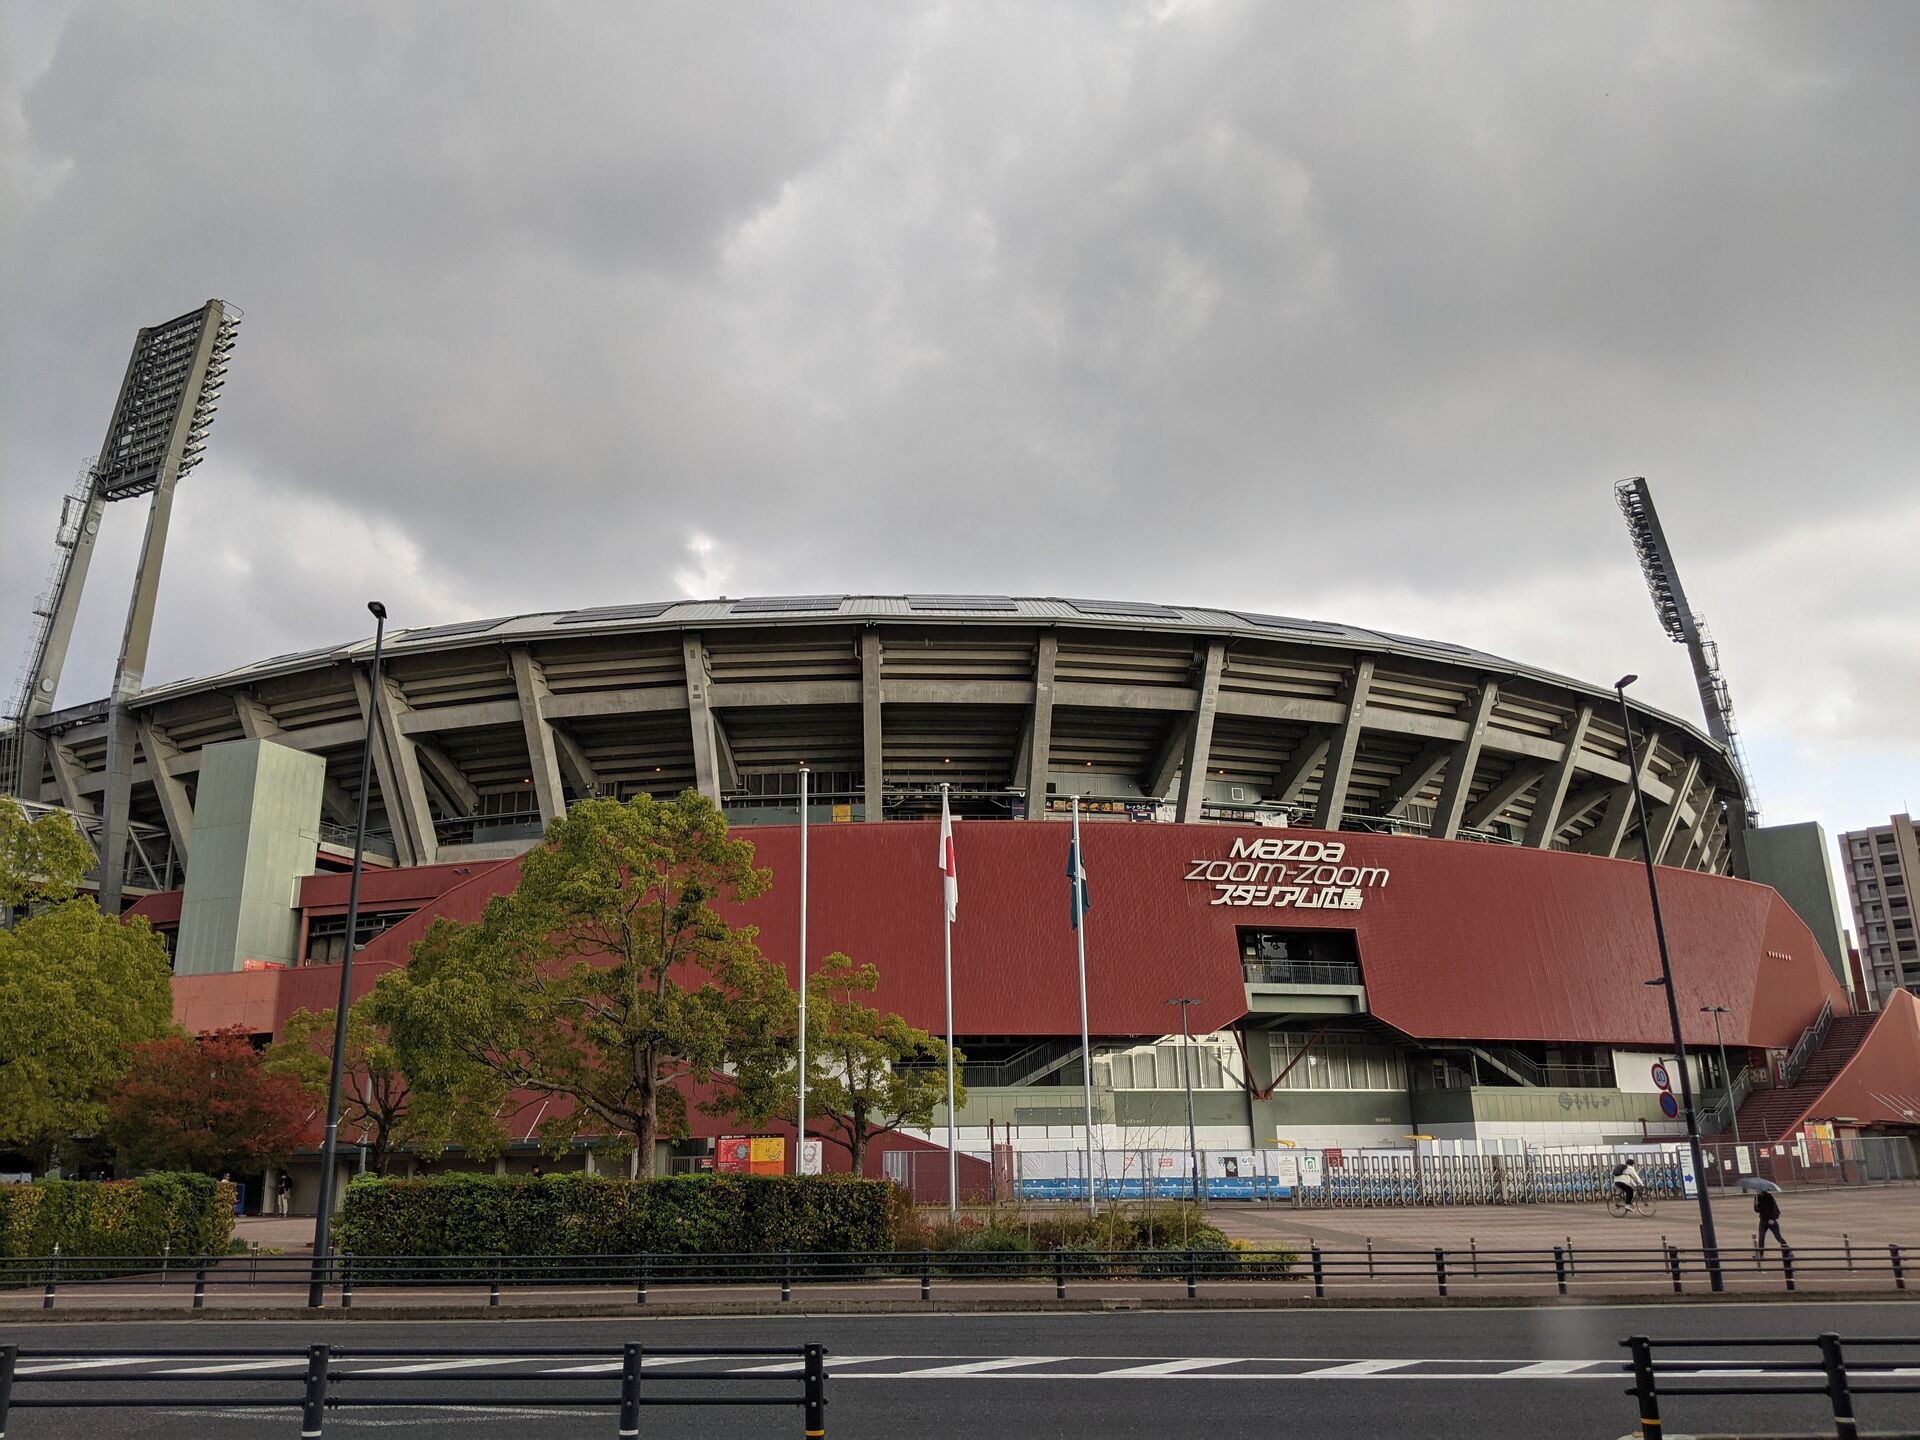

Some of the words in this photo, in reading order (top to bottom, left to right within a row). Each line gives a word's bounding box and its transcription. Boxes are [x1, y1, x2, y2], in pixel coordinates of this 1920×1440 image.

[1210, 884, 1364, 910] スタジアム広島
[1656, 1070, 1666, 1082] 40
